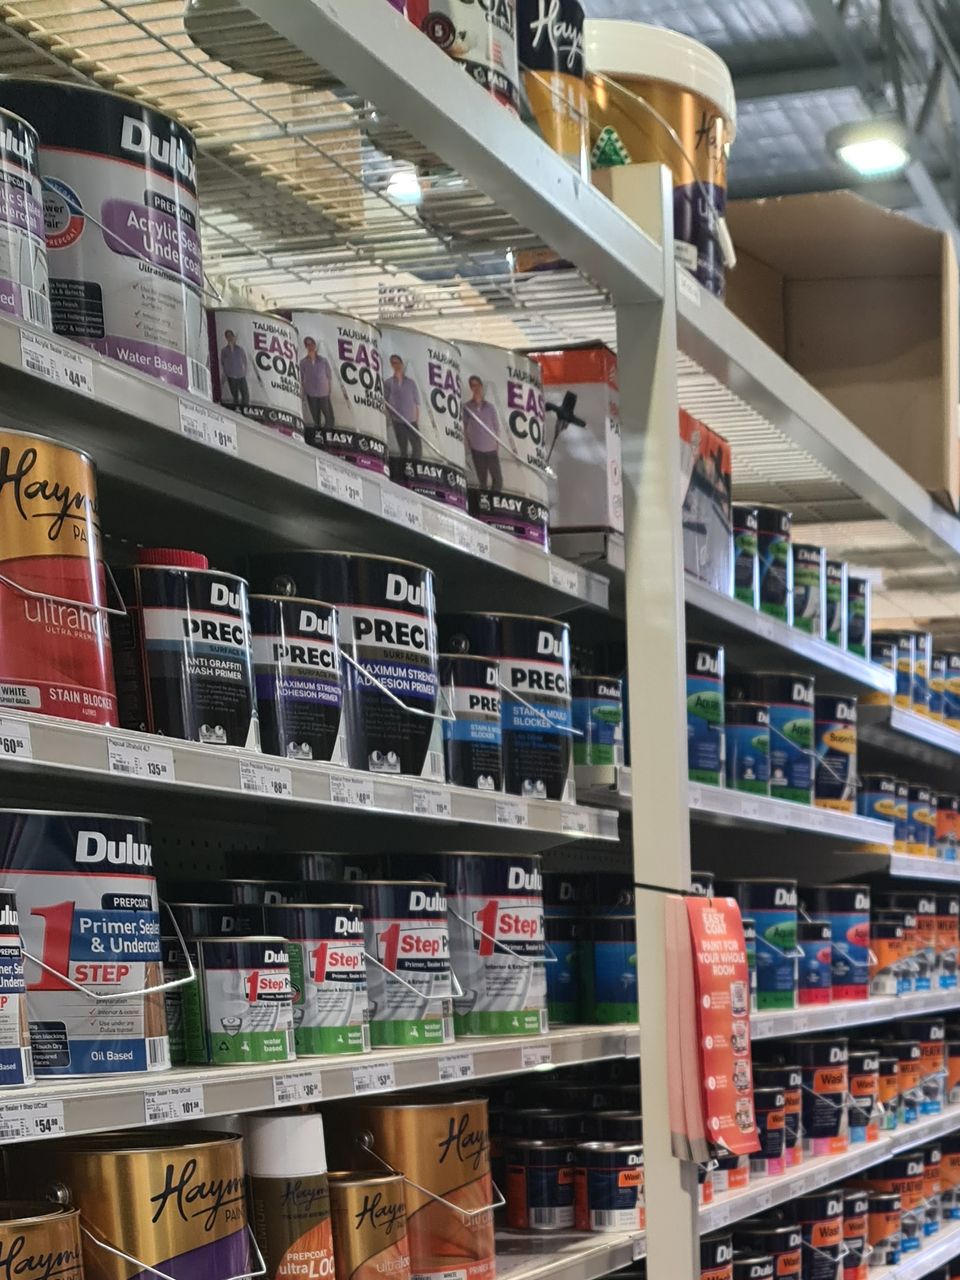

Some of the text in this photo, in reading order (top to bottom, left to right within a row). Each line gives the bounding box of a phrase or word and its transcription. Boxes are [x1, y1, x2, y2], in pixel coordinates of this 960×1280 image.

[121, 115, 196, 184] Dulux
[127, 209, 177, 242] Acrylic
[117, 347, 183, 376] Water Based
[338, 338, 381, 373] EAS
[340, 362, 383, 397] COA
[326, 429, 353, 445] EASY
[416, 464, 443, 479] EASY
[493, 496, 523, 513] EASY
[386, 572, 426, 607] Dul
[300, 610, 333, 637] Dul
[209, 658, 242, 673] GRAFFITI
[359, 662, 407, 678] MAXIMUM
[216, 671, 242, 681] PRIMER
[2, 686, 27, 697] WHITE
[319, 690, 338, 702] PRIMER
[411, 683, 436, 697] PRIMER
[49, 687, 113, 711] STAIN BLOCKER
[75, 830, 152, 867] Dulux
[507, 866, 542, 891] Dulu
[113, 897, 149, 909] PREPCOAT
[408, 890, 448, 912] Dulu
[79, 917, 138, 937] Primer,
[499, 913, 538, 939] Step
[91, 938, 105, 953] &
[401, 934, 440, 956] Step
[701, 939, 739, 952] PAINT FOR
[328, 952, 359, 970] Step
[697, 951, 746, 964] YOUR WHOLE
[74, 965, 129, 983] STEP
[259, 978, 284, 992] Step
[91, 1050, 134, 1062] Oil Based
[286, 1248, 328, 1262] PREPCOAT
